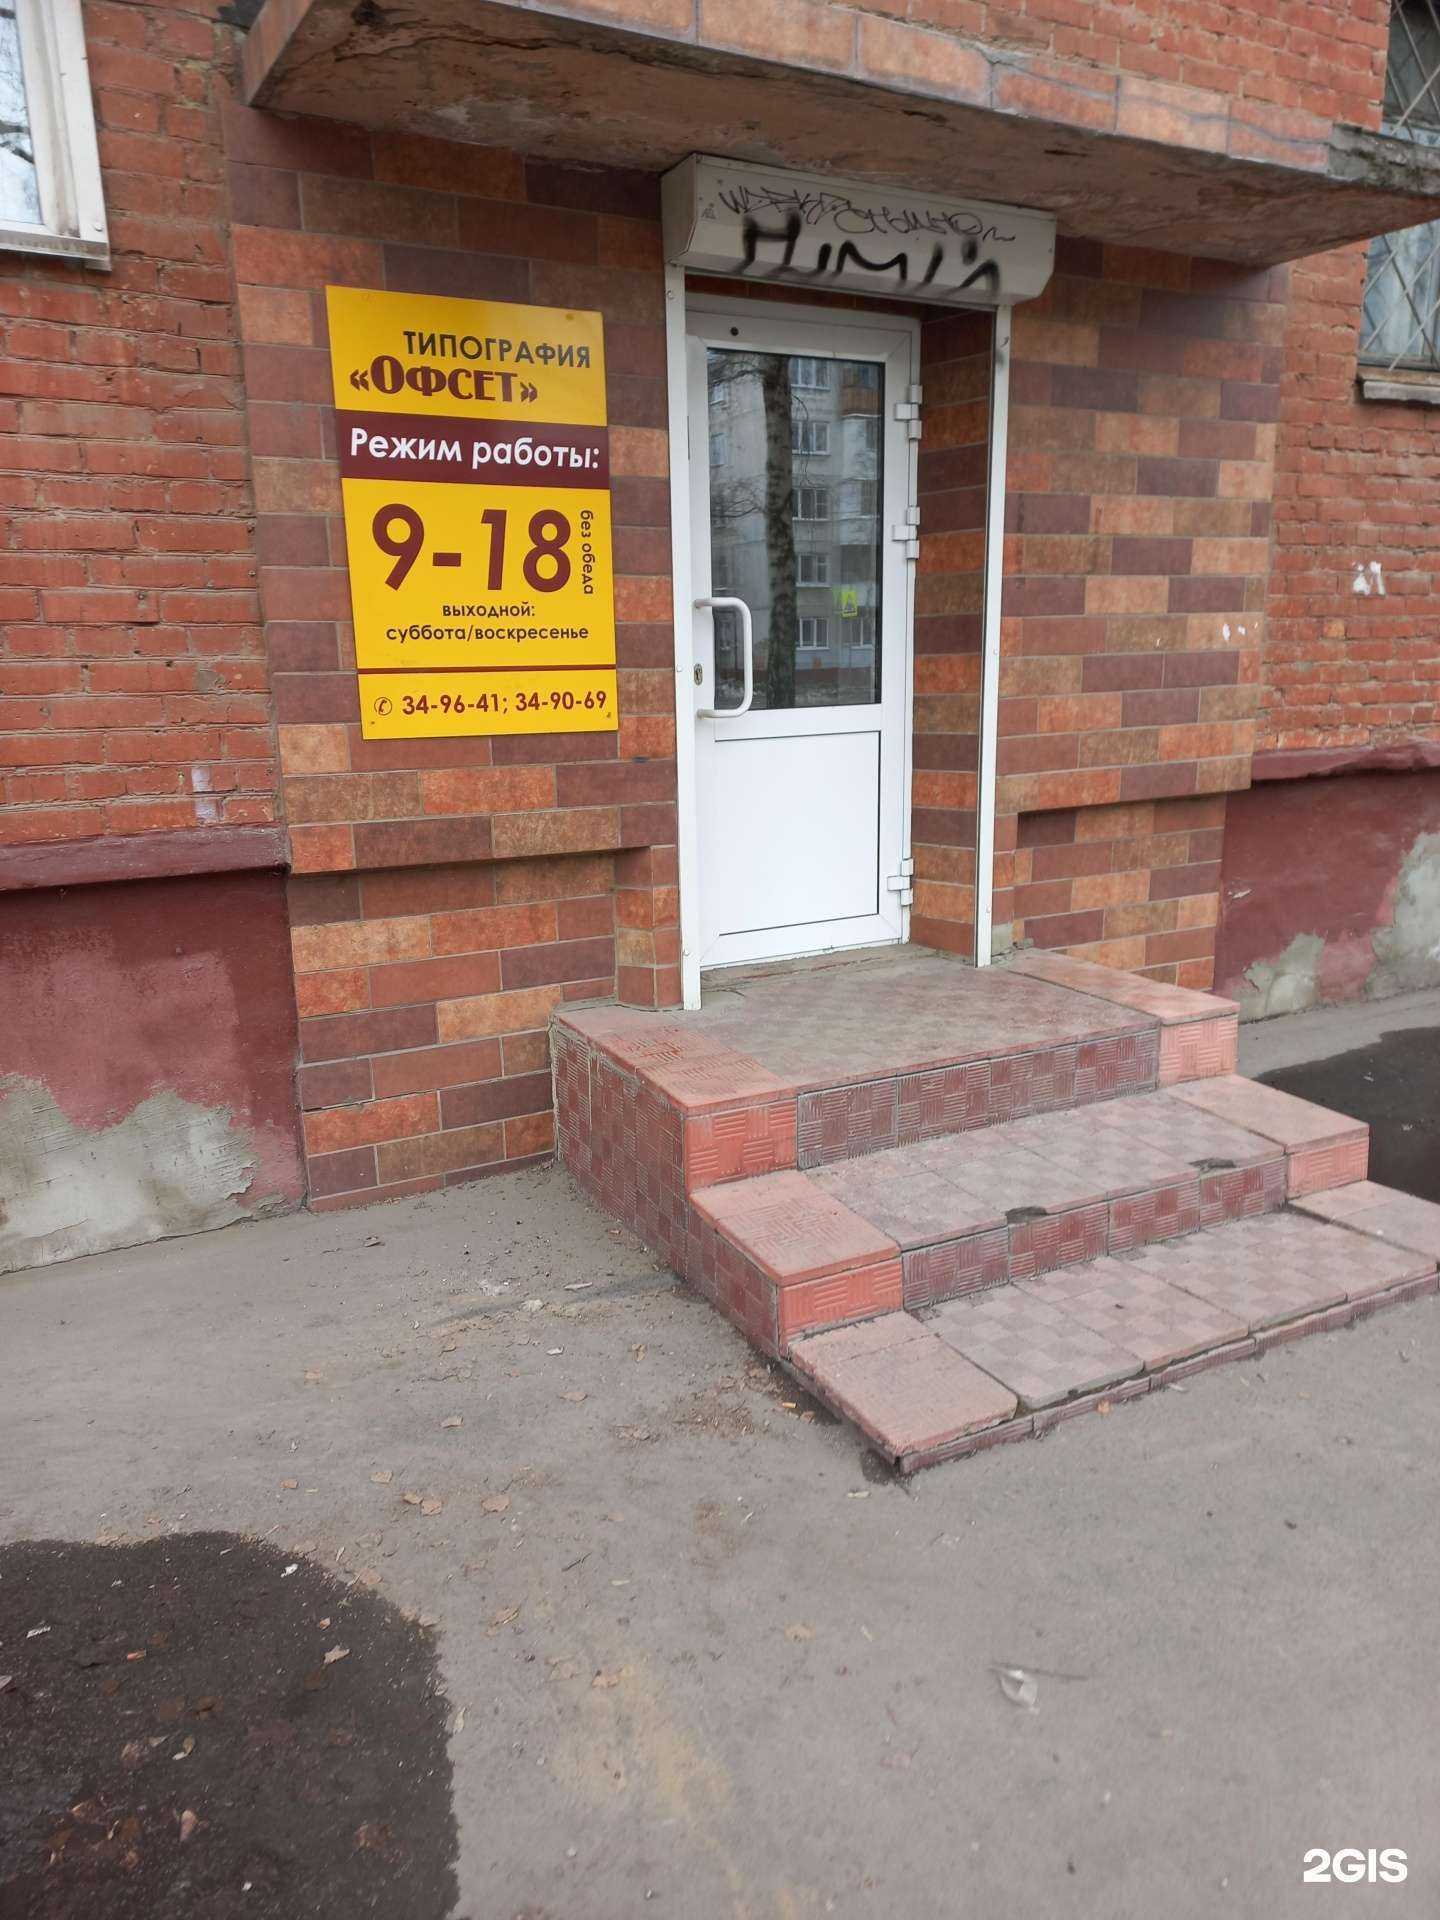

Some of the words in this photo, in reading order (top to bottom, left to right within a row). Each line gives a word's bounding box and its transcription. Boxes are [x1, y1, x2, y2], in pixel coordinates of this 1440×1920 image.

[402, 330, 591, 369] ТИПОГРАФИЯ
[350, 427, 462, 462] Режим
[472, 437, 600, 470] работы:
[580, 509, 594, 539] без
[371, 502, 572, 593] 9-18
[581, 542, 596, 595] обеда
[442, 601, 536, 618] выходной:
[385, 624, 589, 643] суббота/воскресенье
[402, 692, 509, 716] 34-96-41;
[515, 690, 607, 713] 34-90-69
